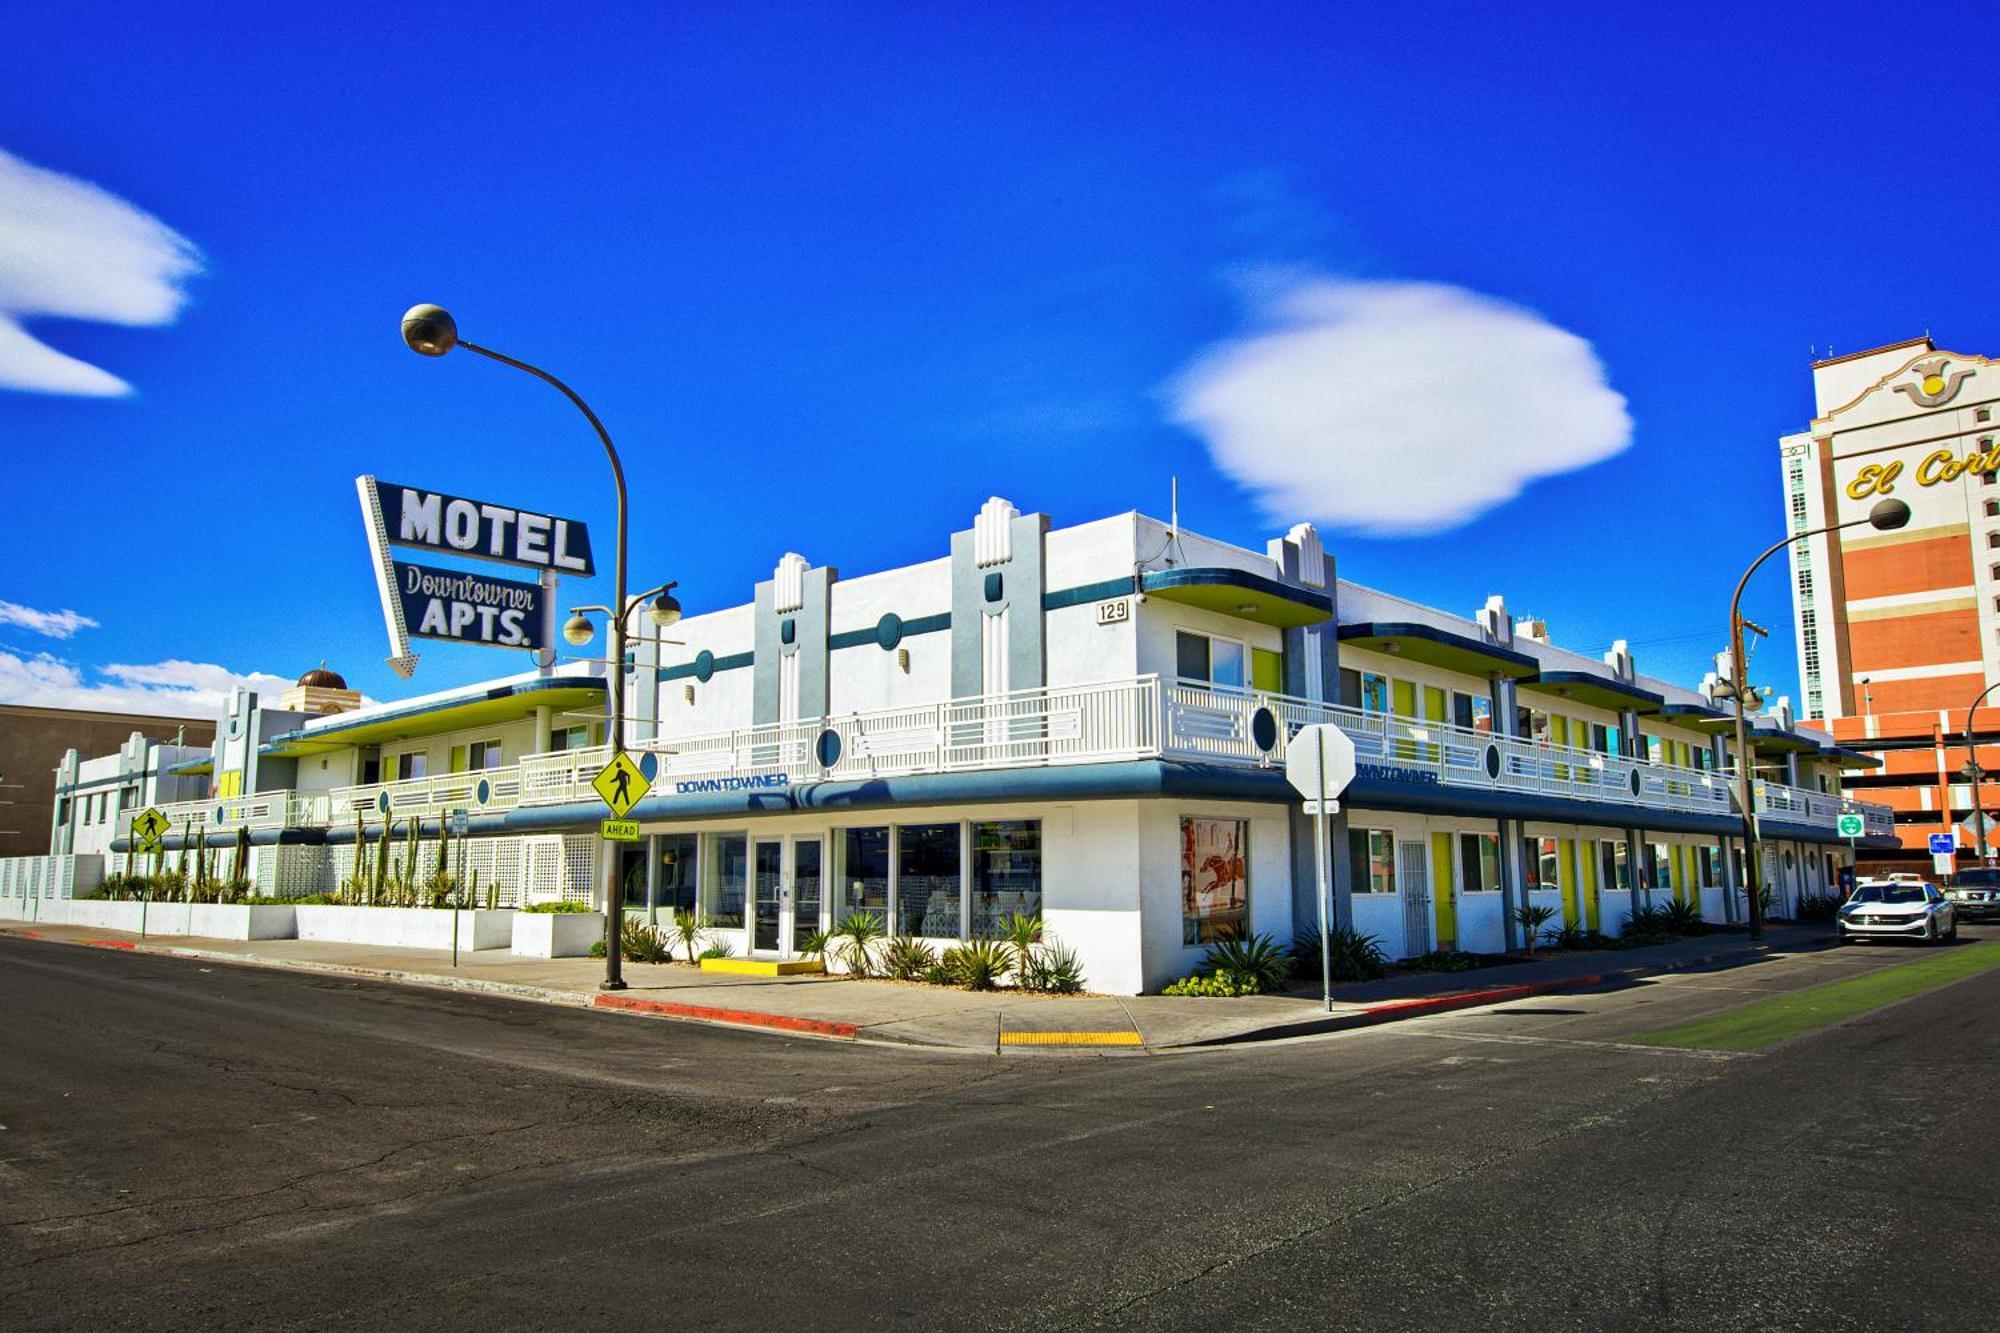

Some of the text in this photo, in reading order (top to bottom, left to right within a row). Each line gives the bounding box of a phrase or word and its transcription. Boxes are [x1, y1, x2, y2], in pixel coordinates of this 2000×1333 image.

[1847, 461, 1903, 499] El
[401, 488, 586, 571] MOTEL
[406, 566, 534, 610] Downtowner
[420, 598, 532, 646] APTS.
[1101, 602, 1125, 620] 129
[677, 773, 788, 794] DOWNTOWNER
[606, 824, 636, 837] AHEAD
